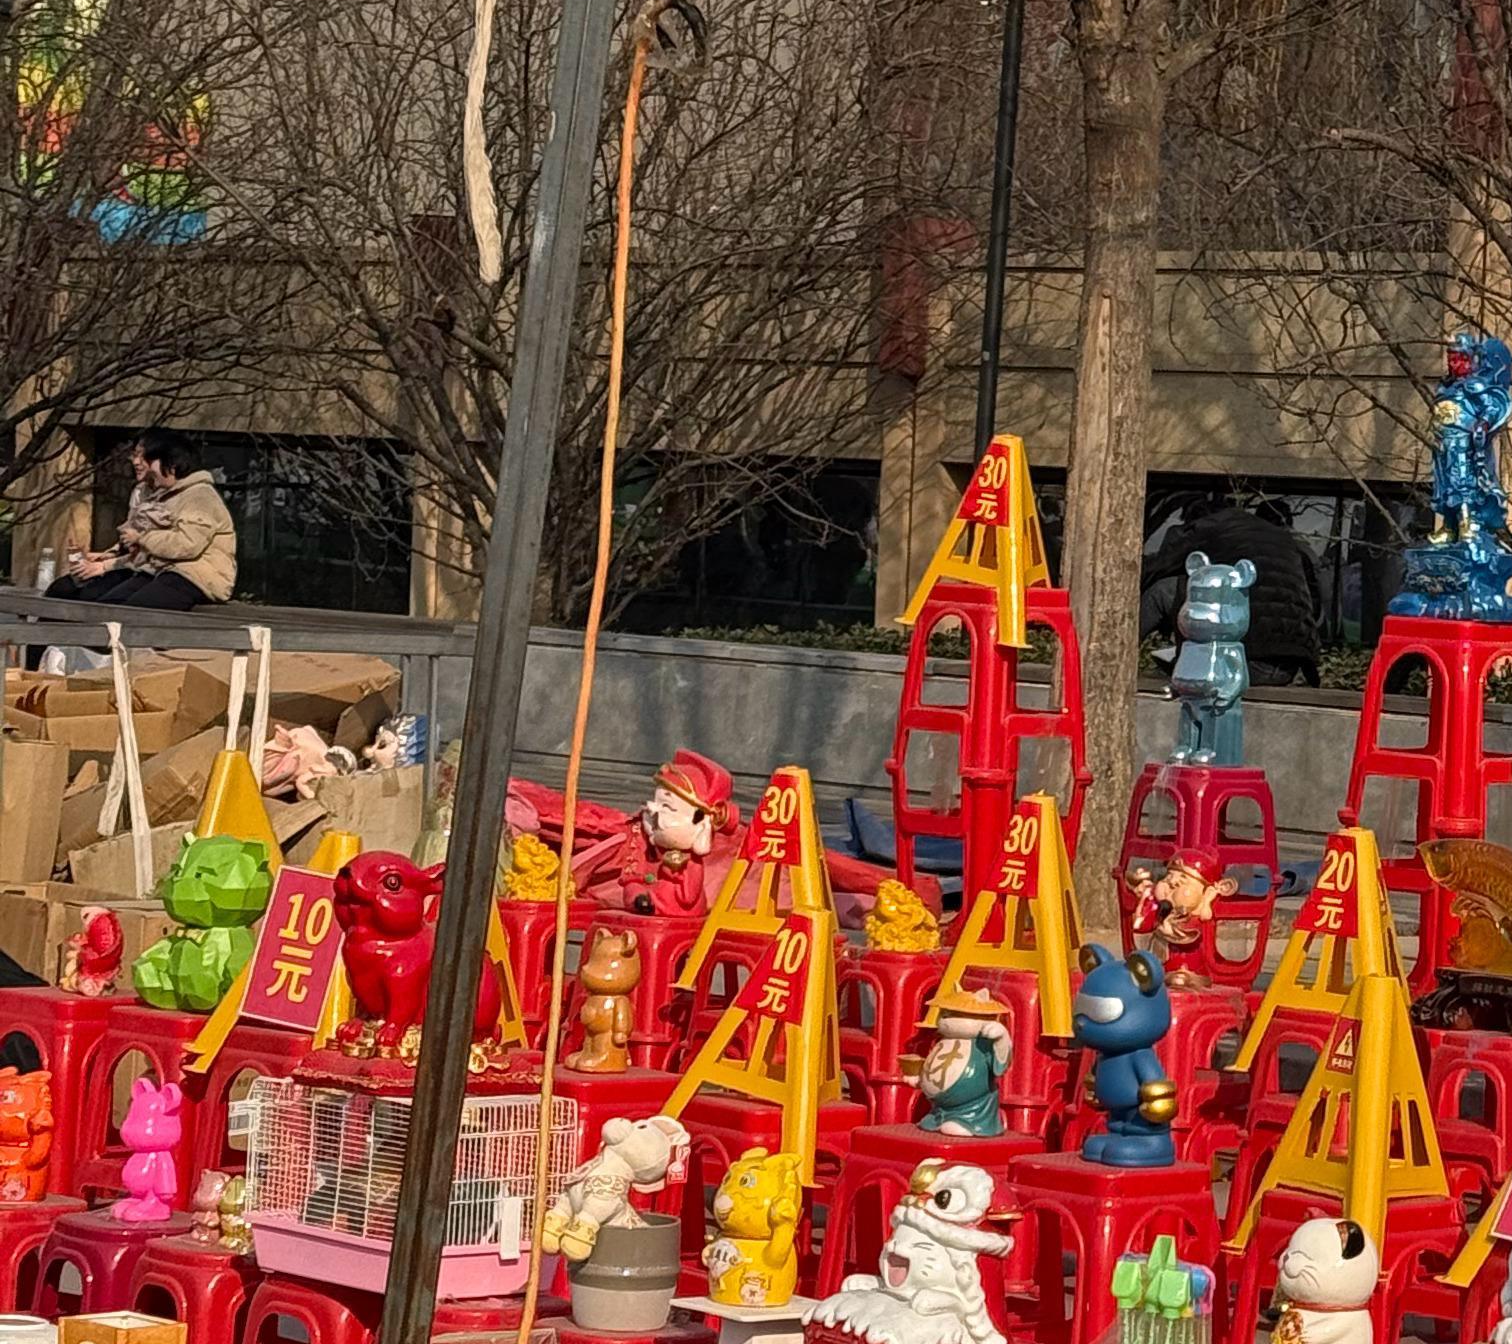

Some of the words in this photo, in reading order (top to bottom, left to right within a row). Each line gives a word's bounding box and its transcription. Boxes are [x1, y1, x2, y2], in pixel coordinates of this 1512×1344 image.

[978, 454, 1008, 489] 30
[973, 492, 998, 520] 元
[760, 785, 798, 825] 30
[756, 829, 786, 859] 元
[1003, 814, 1038, 855] 30
[998, 859, 1027, 890] 元
[1316, 849, 1355, 892] 20
[277, 893, 333, 945] 10
[1314, 896, 1345, 929] 元
[773, 928, 808, 974] 10
[265, 944, 314, 1003] 元
[761, 978, 791, 1013] 元
